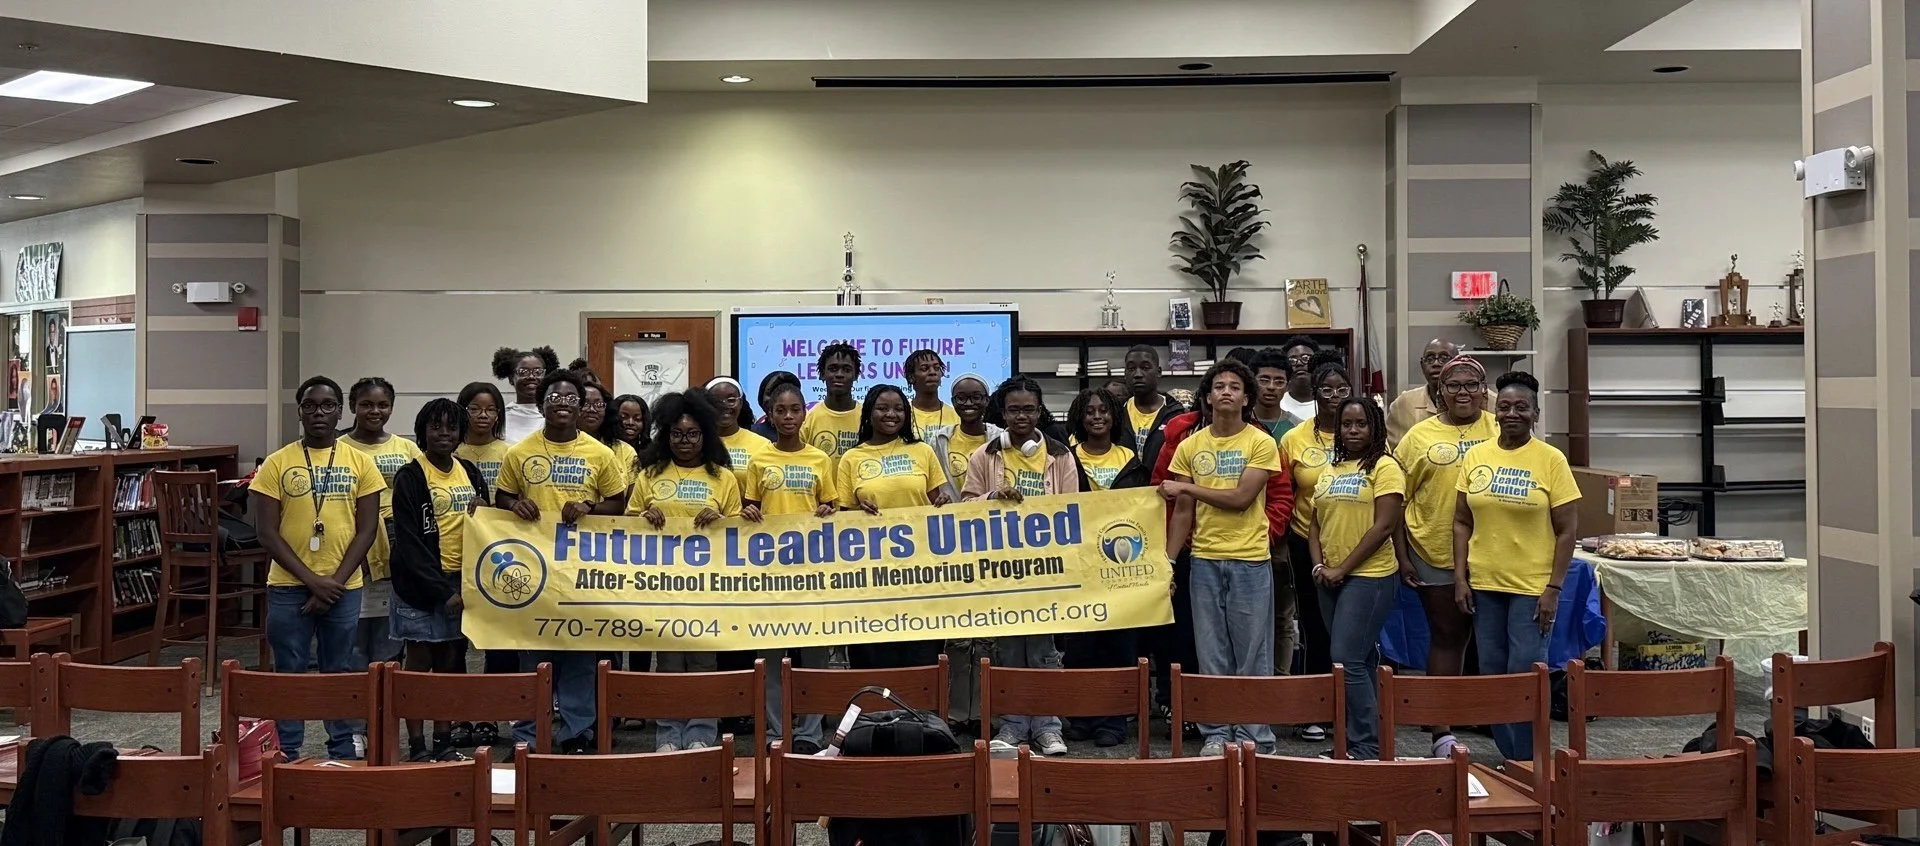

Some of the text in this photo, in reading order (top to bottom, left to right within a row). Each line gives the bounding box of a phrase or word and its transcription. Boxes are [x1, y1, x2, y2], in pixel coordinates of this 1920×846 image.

[782, 337, 966, 357] WELCE TO FUTURE
[838, 430, 860, 438] Futur
[315, 466, 350, 474] Fuure
[553, 465, 592, 476] Leaders
[1496, 466, 1531, 477] Future
[552, 474, 584, 484] United
[1493, 475, 1537, 488] Leaders
[1491, 484, 1528, 496] United
[554, 523, 711, 567] Future
[725, 522, 915, 567] Leaders
[926, 503, 1082, 557] United
[575, 556, 1064, 592] After-School Enrichment and Mentoring Program
[1100, 564, 1154, 580] UNITED
[534, 602, 1108, 638] 770-789-7004 www.unitedfoundationcf.org
